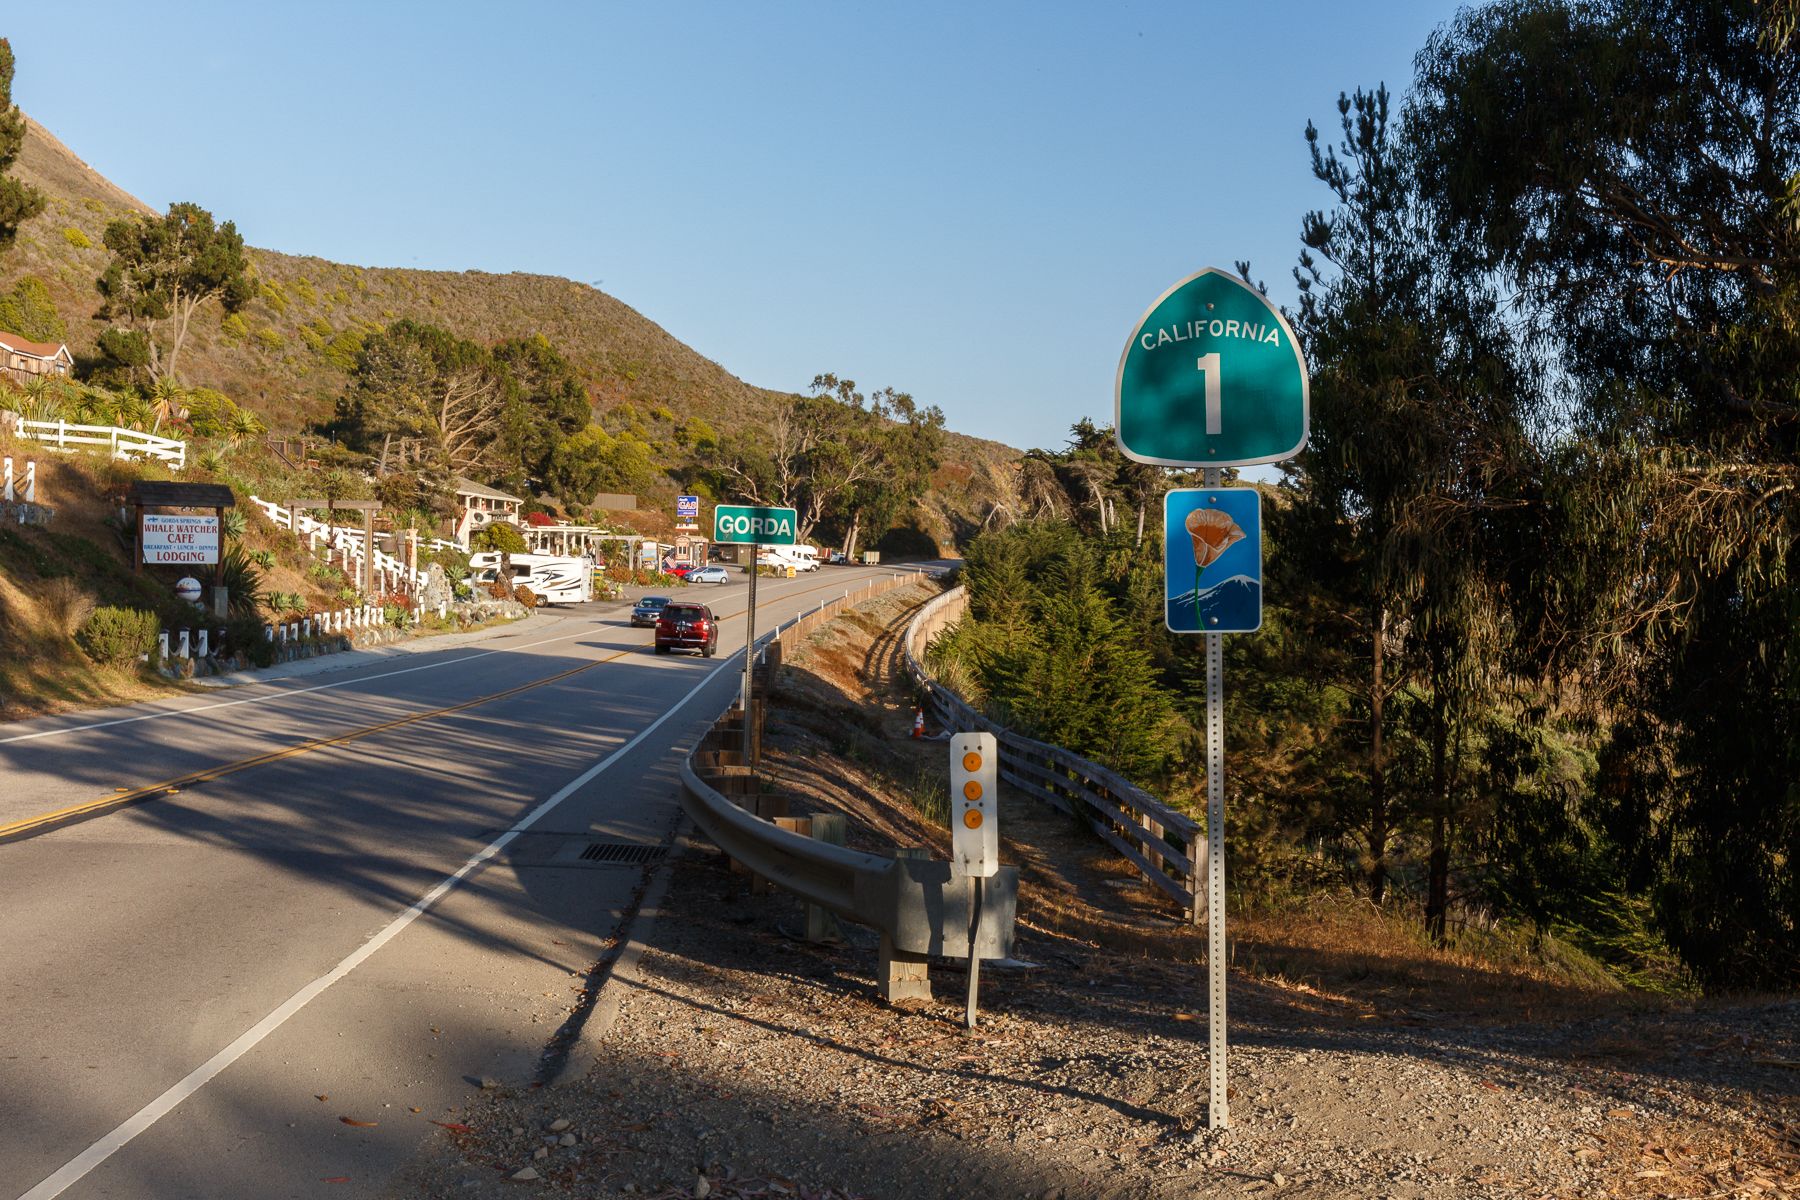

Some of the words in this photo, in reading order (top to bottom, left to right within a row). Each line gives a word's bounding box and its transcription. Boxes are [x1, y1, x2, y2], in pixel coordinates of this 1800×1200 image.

[1141, 319, 1280, 350] CALIFORNIA
[1197, 352, 1222, 435] 1
[679, 501, 697, 510] GAS
[144, 524, 174, 533] WHALE
[176, 525, 217, 534] WATCHER
[718, 514, 792, 537] GORDA
[167, 533, 195, 544] CAFE
[156, 551, 205, 562] LODGING
